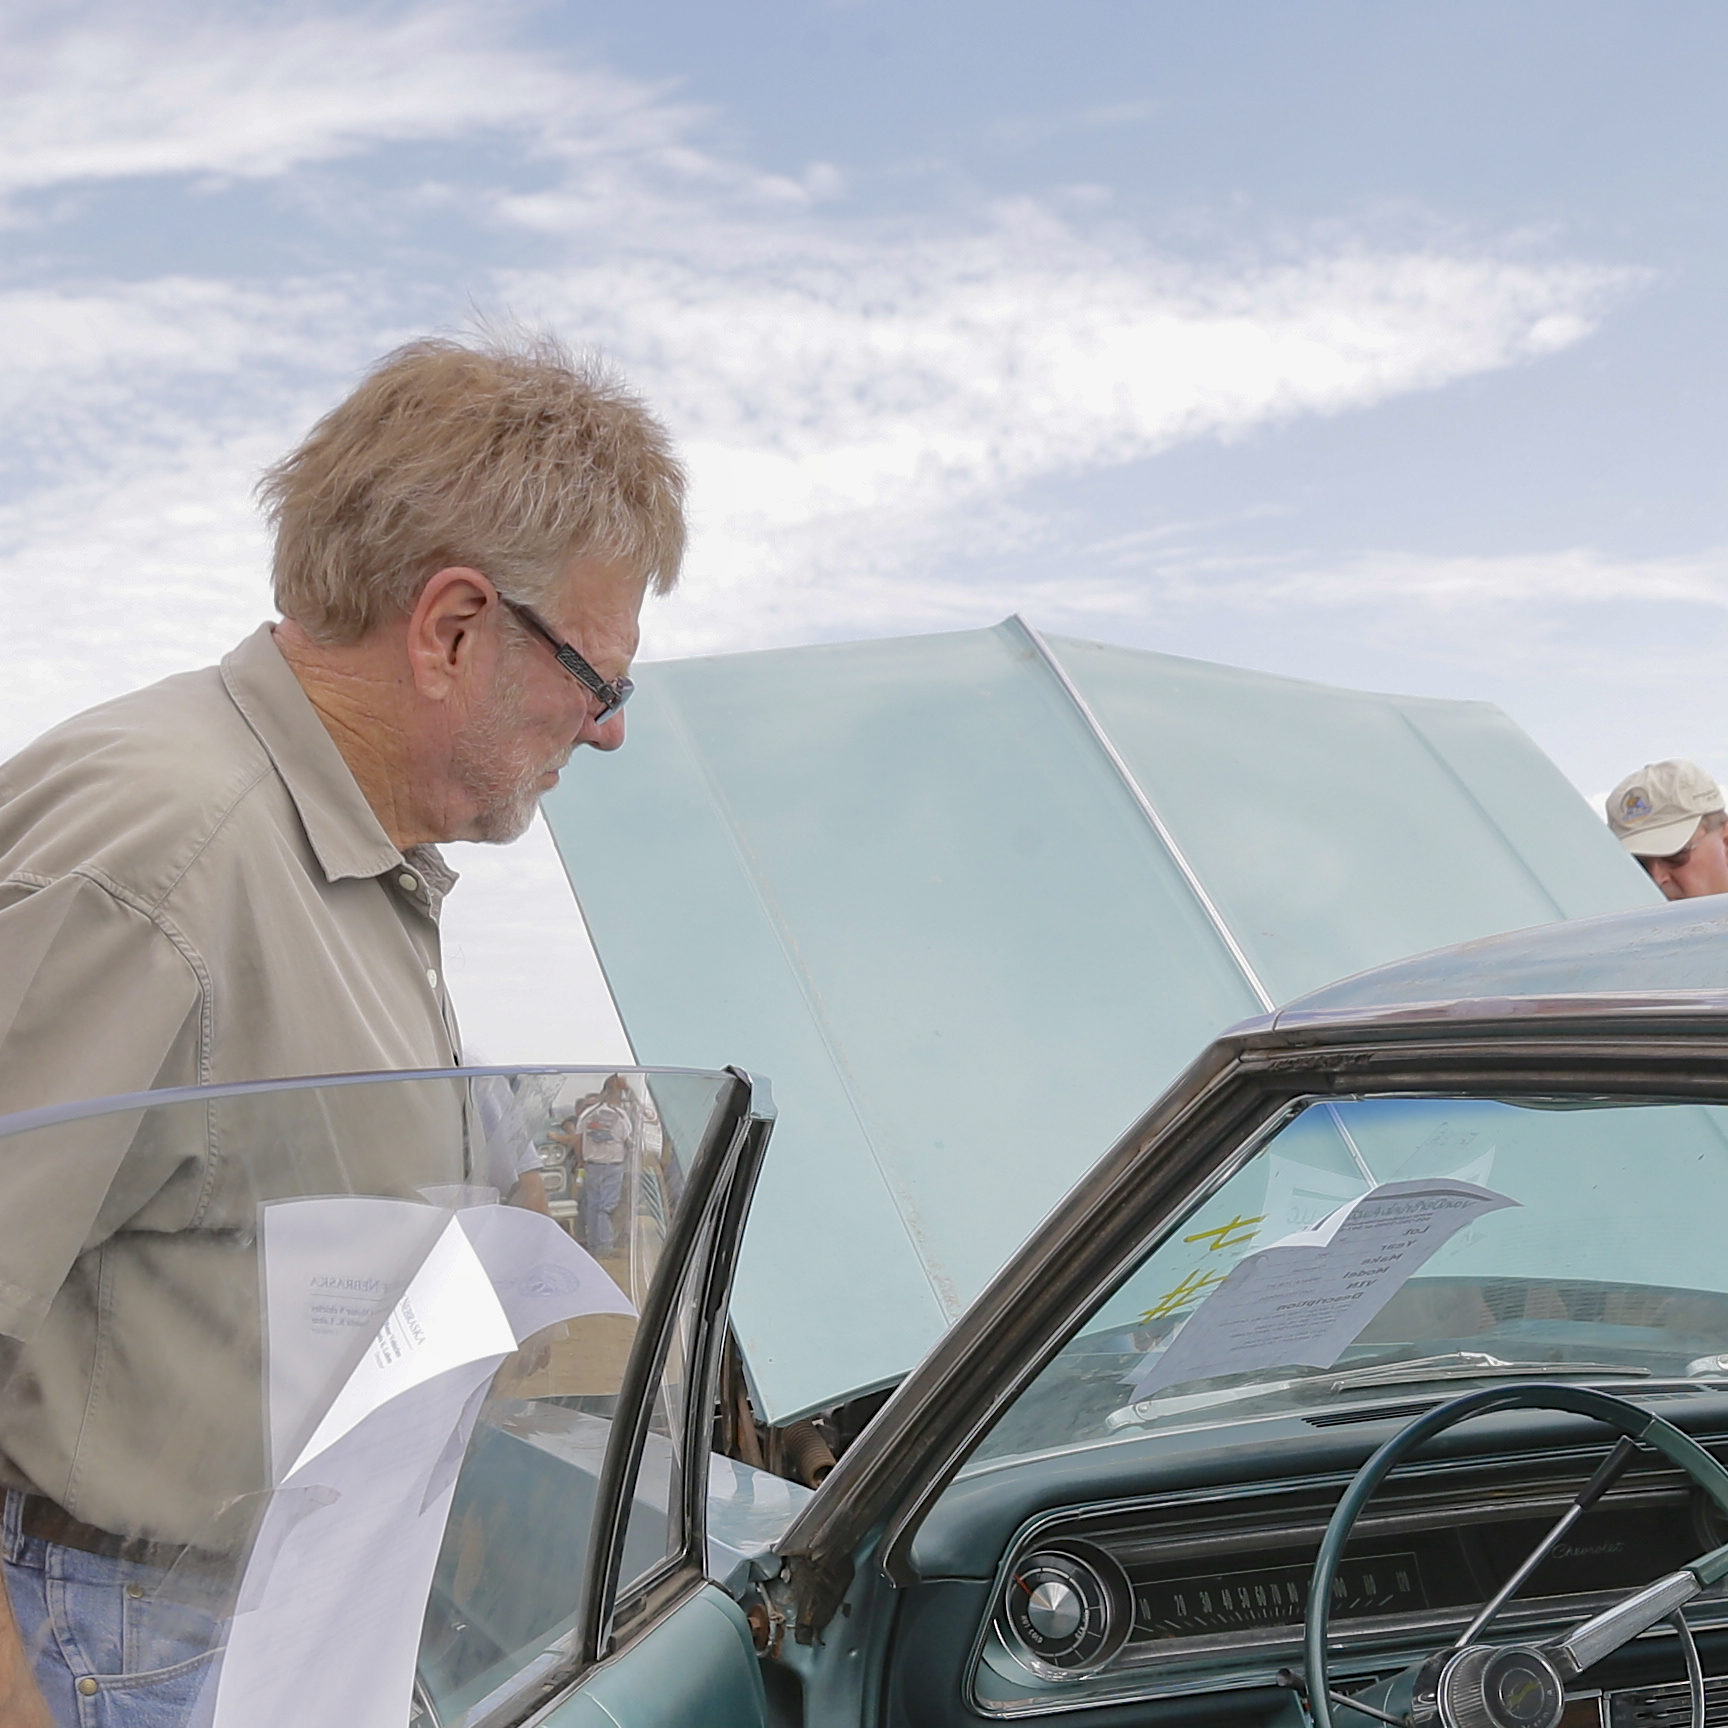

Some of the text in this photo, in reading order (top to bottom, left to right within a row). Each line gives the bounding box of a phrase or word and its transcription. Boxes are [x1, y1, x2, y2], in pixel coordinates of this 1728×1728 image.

[1552, 1542, 1625, 1559] Chevrolet
[1141, 1598, 1152, 1621] 10
[1174, 1594, 1187, 1617] 20
[1199, 1591, 1212, 1613] 30
[1221, 1588, 1233, 1610] 40
[1238, 1587, 1250, 1608] 50
[1255, 1585, 1267, 1606] 60
[1269, 1583, 1282, 1605] 70
[1287, 1582, 1299, 1603] 80
